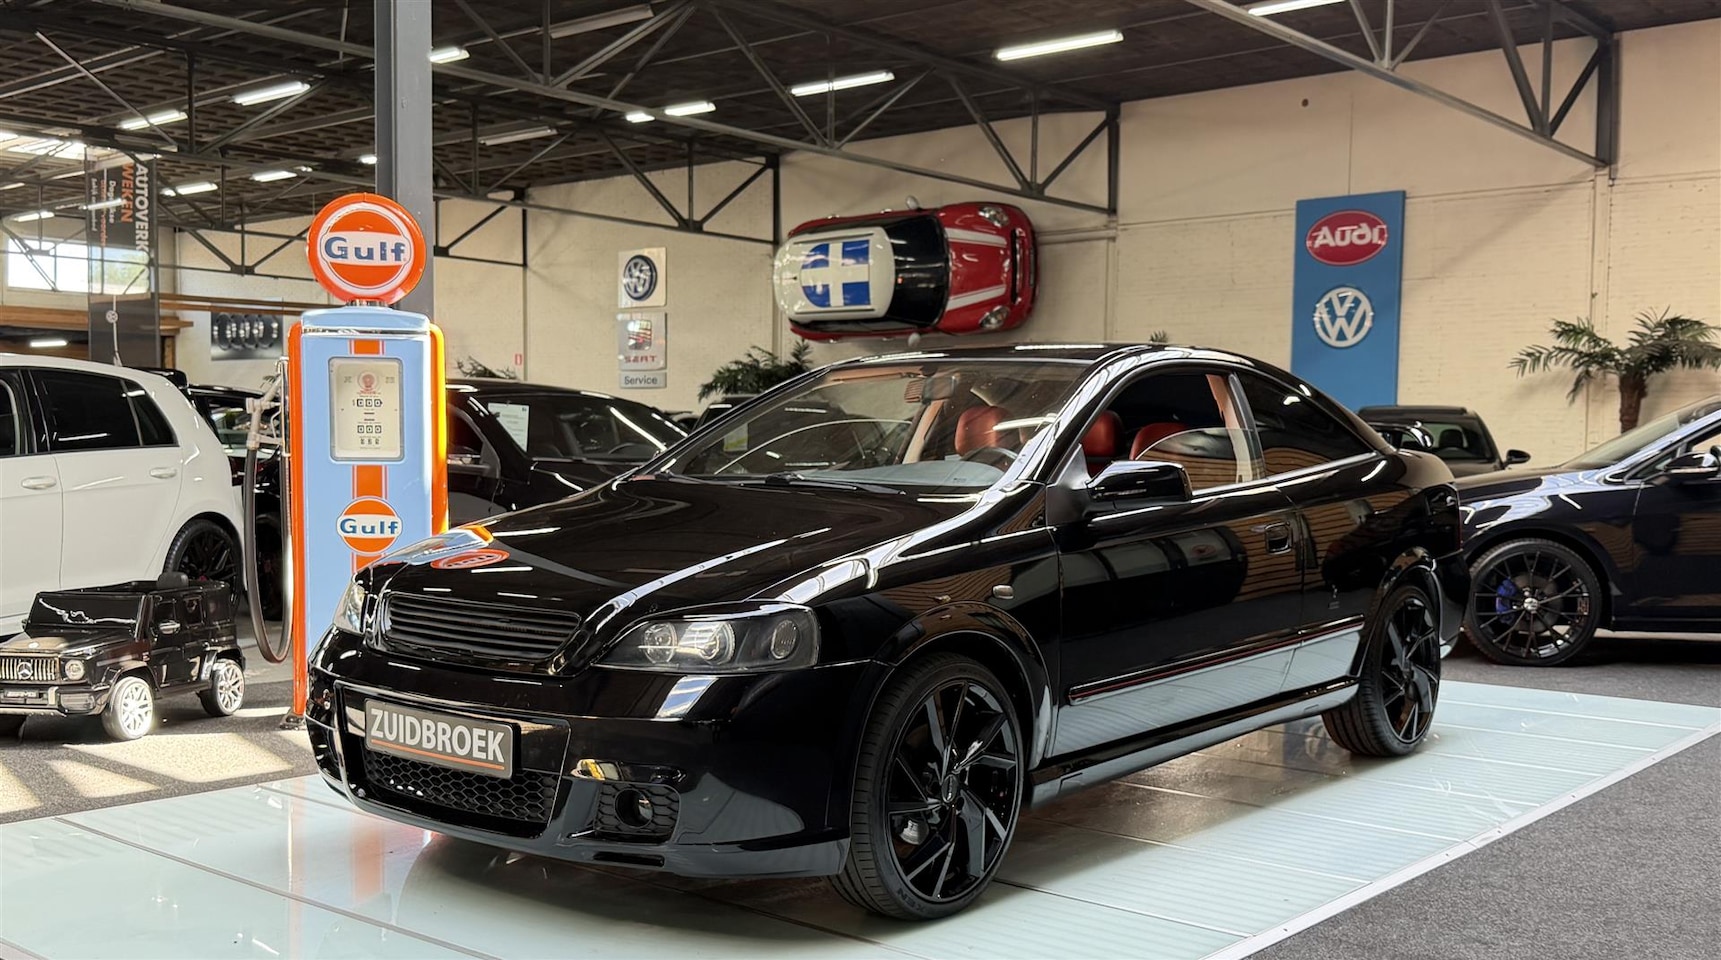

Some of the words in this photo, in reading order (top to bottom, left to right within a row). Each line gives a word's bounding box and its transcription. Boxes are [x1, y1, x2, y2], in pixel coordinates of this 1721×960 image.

[121, 162, 134, 223] WEKEN
[324, 236, 406, 262] Gulf
[624, 355, 657, 364] SEAT
[624, 374, 658, 385] Service
[340, 518, 399, 535] Gulf
[370, 708, 505, 763] ZUIDBROEK
